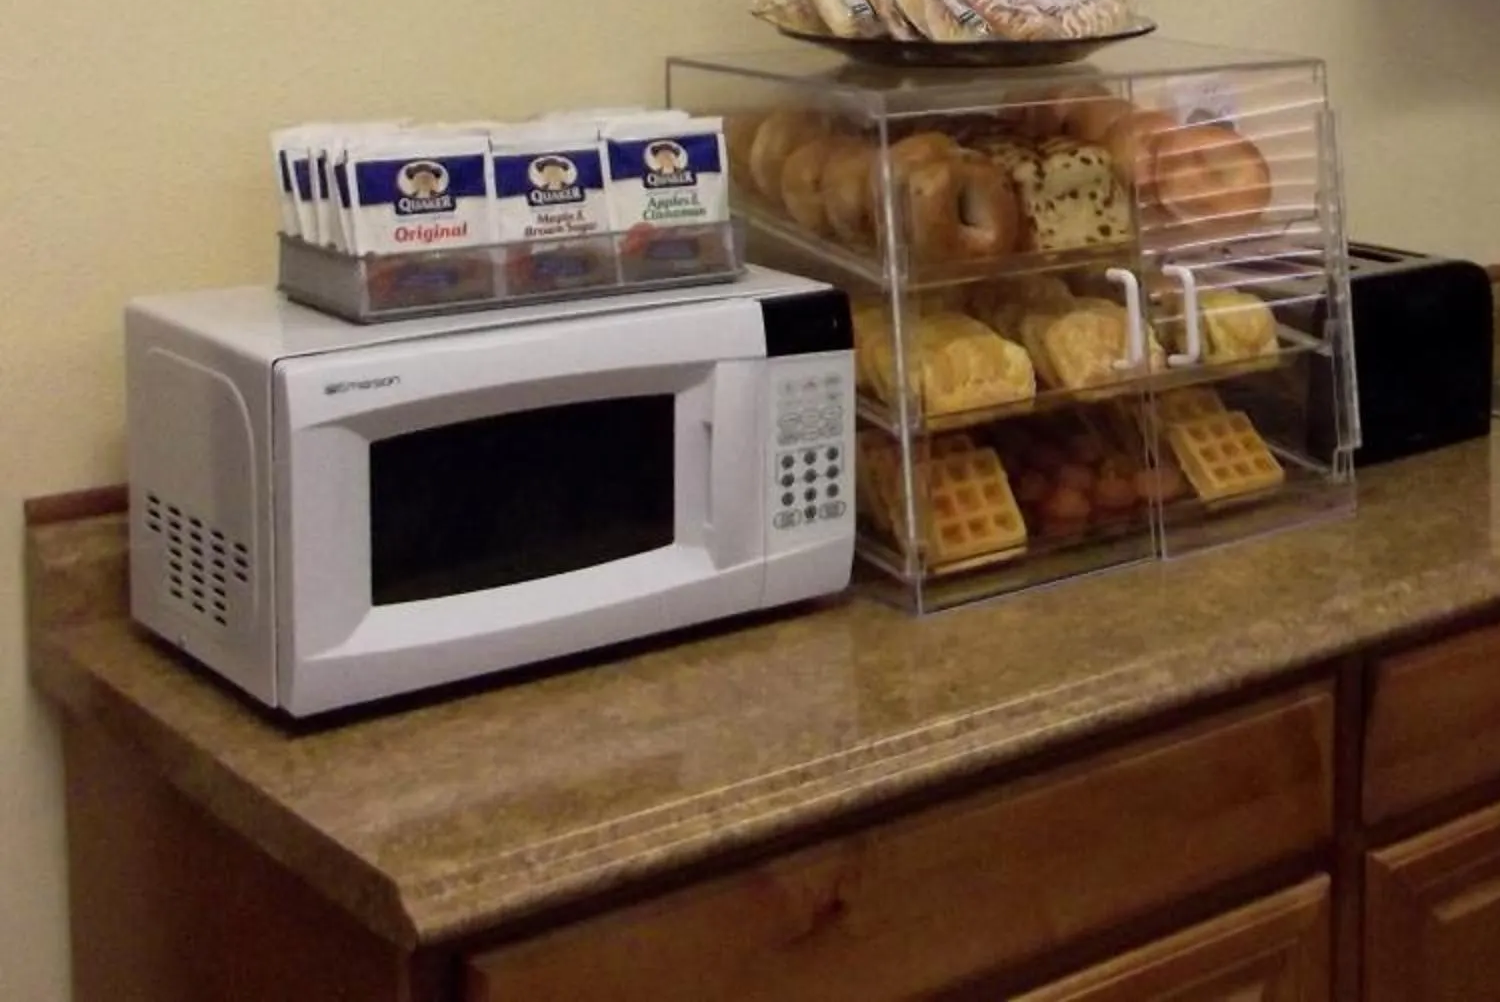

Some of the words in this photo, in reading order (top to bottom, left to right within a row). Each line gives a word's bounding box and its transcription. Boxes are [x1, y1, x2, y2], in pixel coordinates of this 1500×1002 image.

[647, 170, 694, 187] QUAKER
[398, 195, 452, 212] QUAKER
[531, 186, 581, 205] QUAKER
[394, 220, 467, 243] Original
